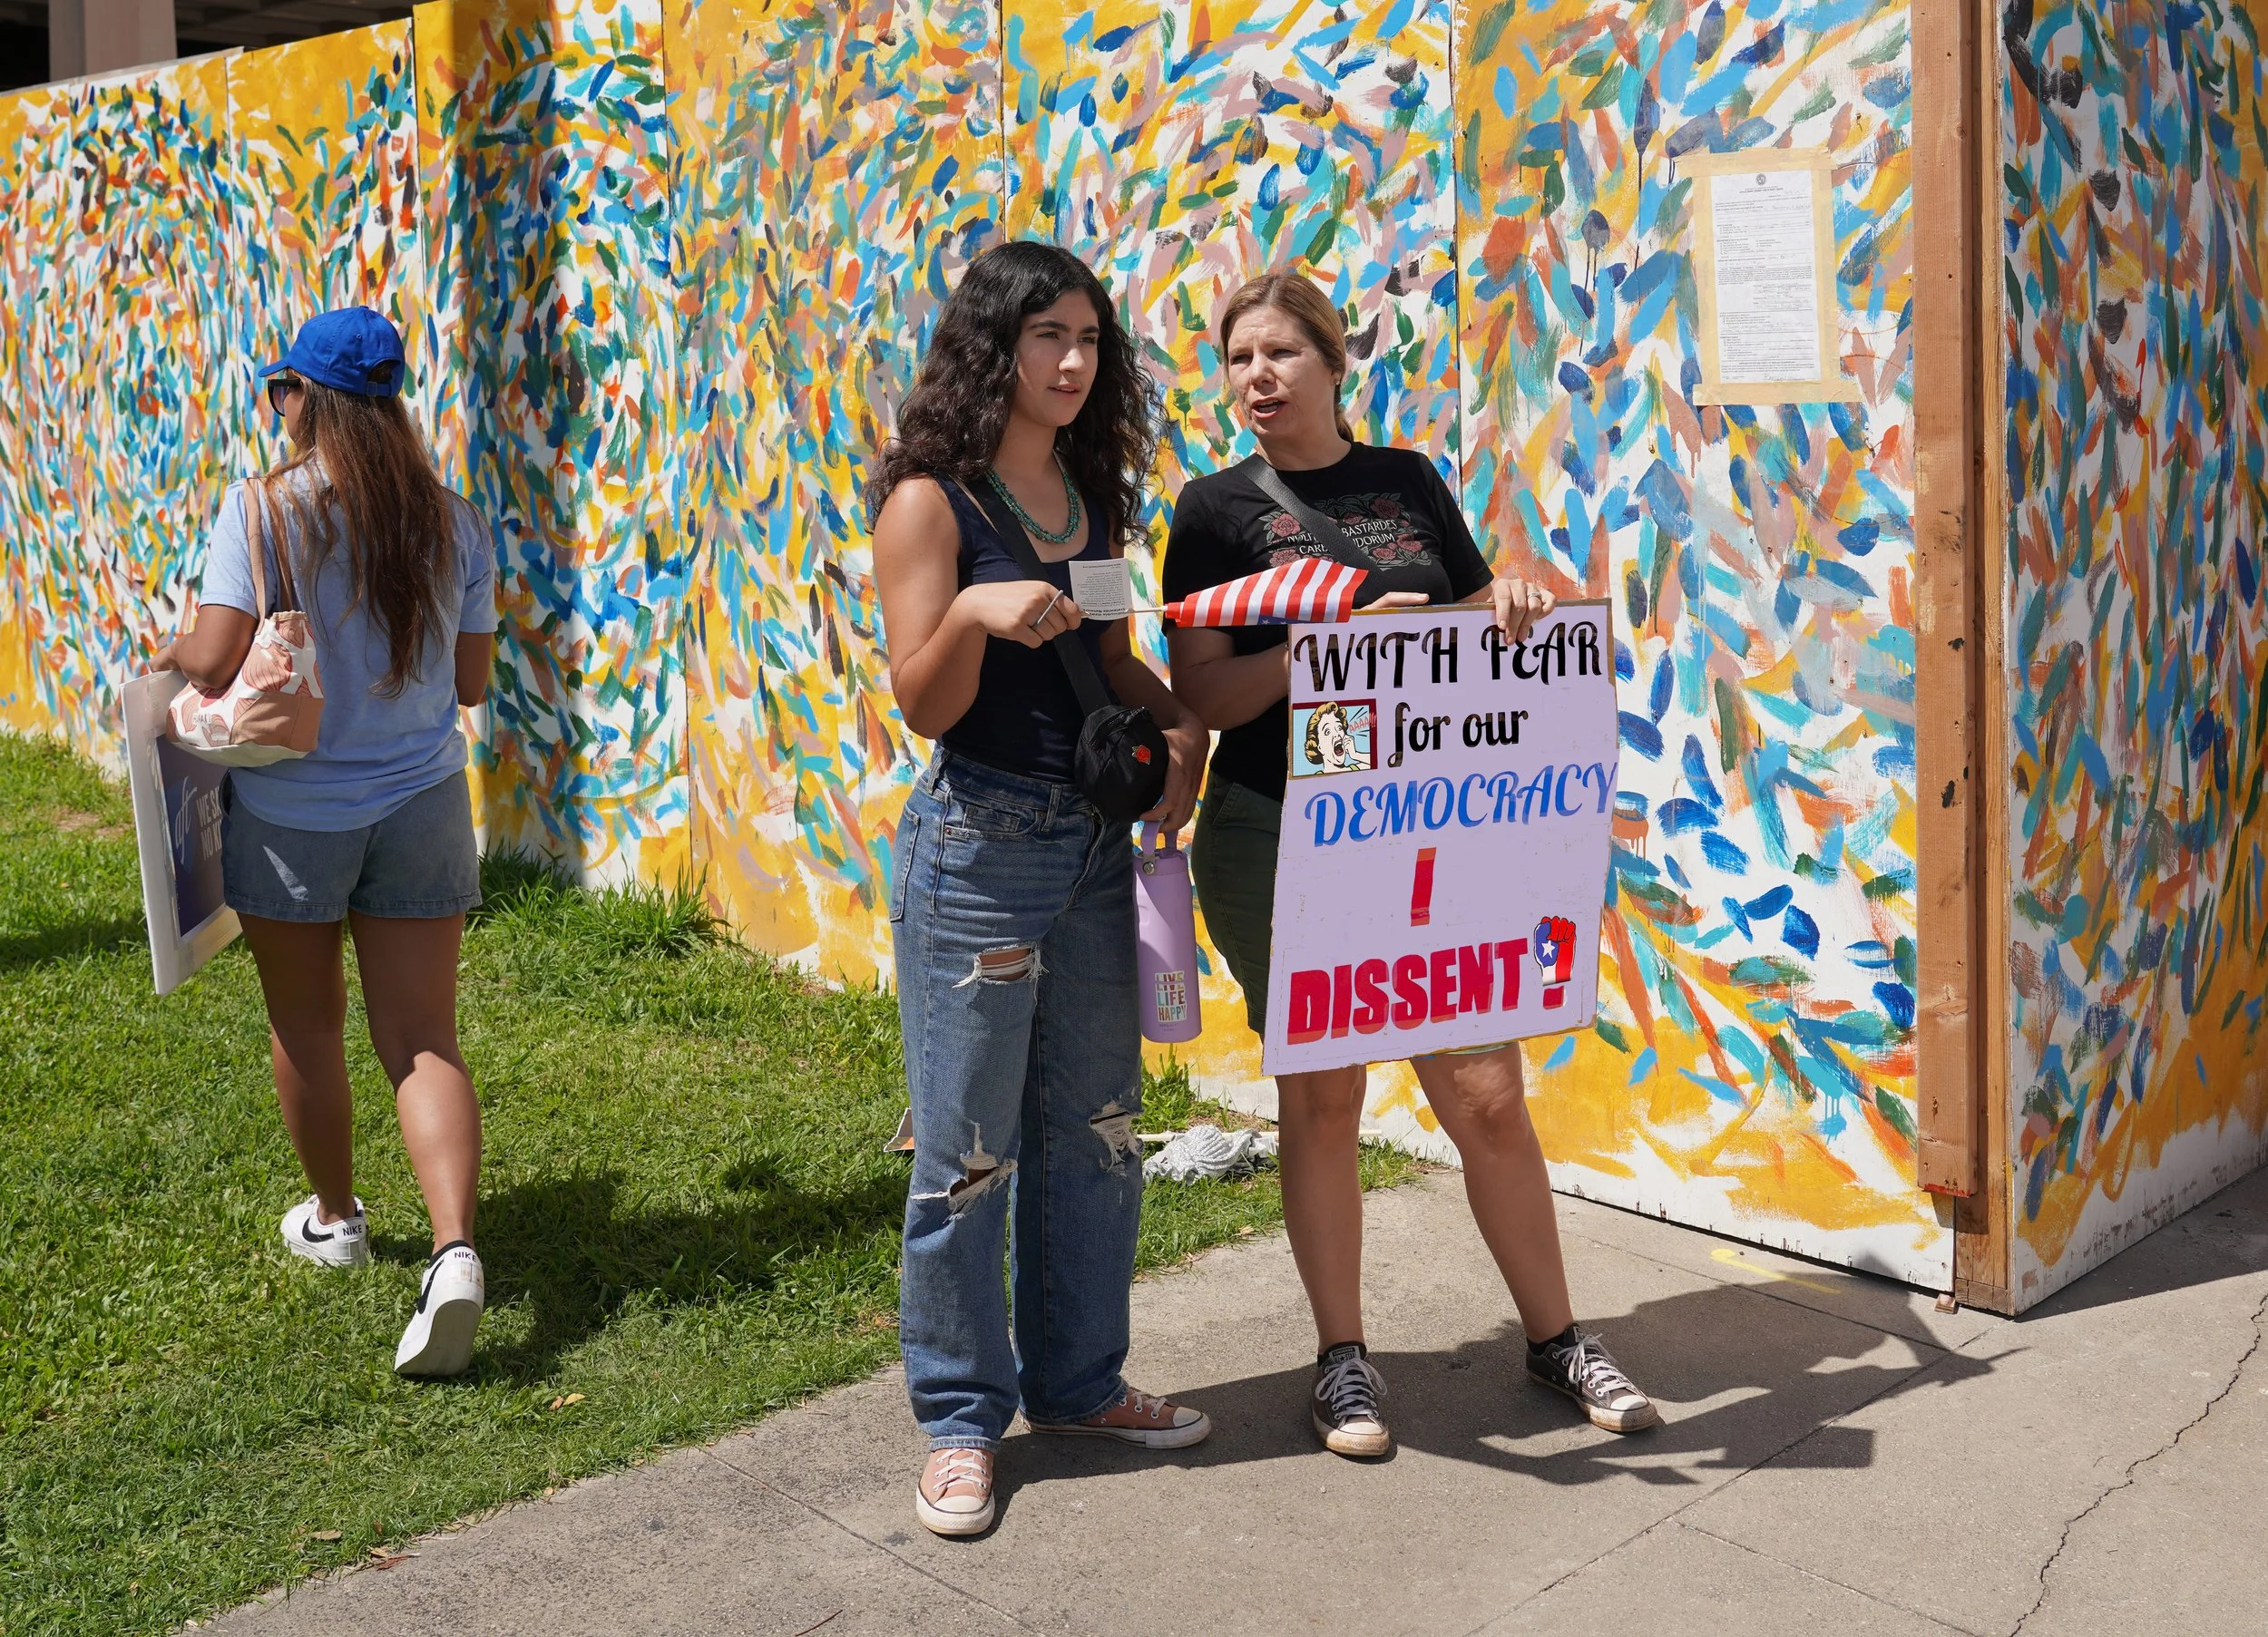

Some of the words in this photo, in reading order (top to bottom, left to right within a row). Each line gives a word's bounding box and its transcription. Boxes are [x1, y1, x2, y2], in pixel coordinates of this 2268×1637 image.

[1341, 519, 1398, 538] BASTARDES
[1294, 626, 1459, 692] WITH
[1481, 620, 1602, 686] FEAR
[1387, 701, 1452, 768] for
[1462, 706, 1530, 747] our
[196, 794, 211, 828] WE
[210, 786, 222, 819] SA
[1305, 762, 1618, 847] DEMOCRACY
[200, 827, 214, 861] NO
[1158, 990, 1186, 1006] LIFE
[1158, 1005, 1187, 1021] HAPPY
[342, 1224, 363, 1236] NIKE
[455, 1252, 476, 1262] NIKE
